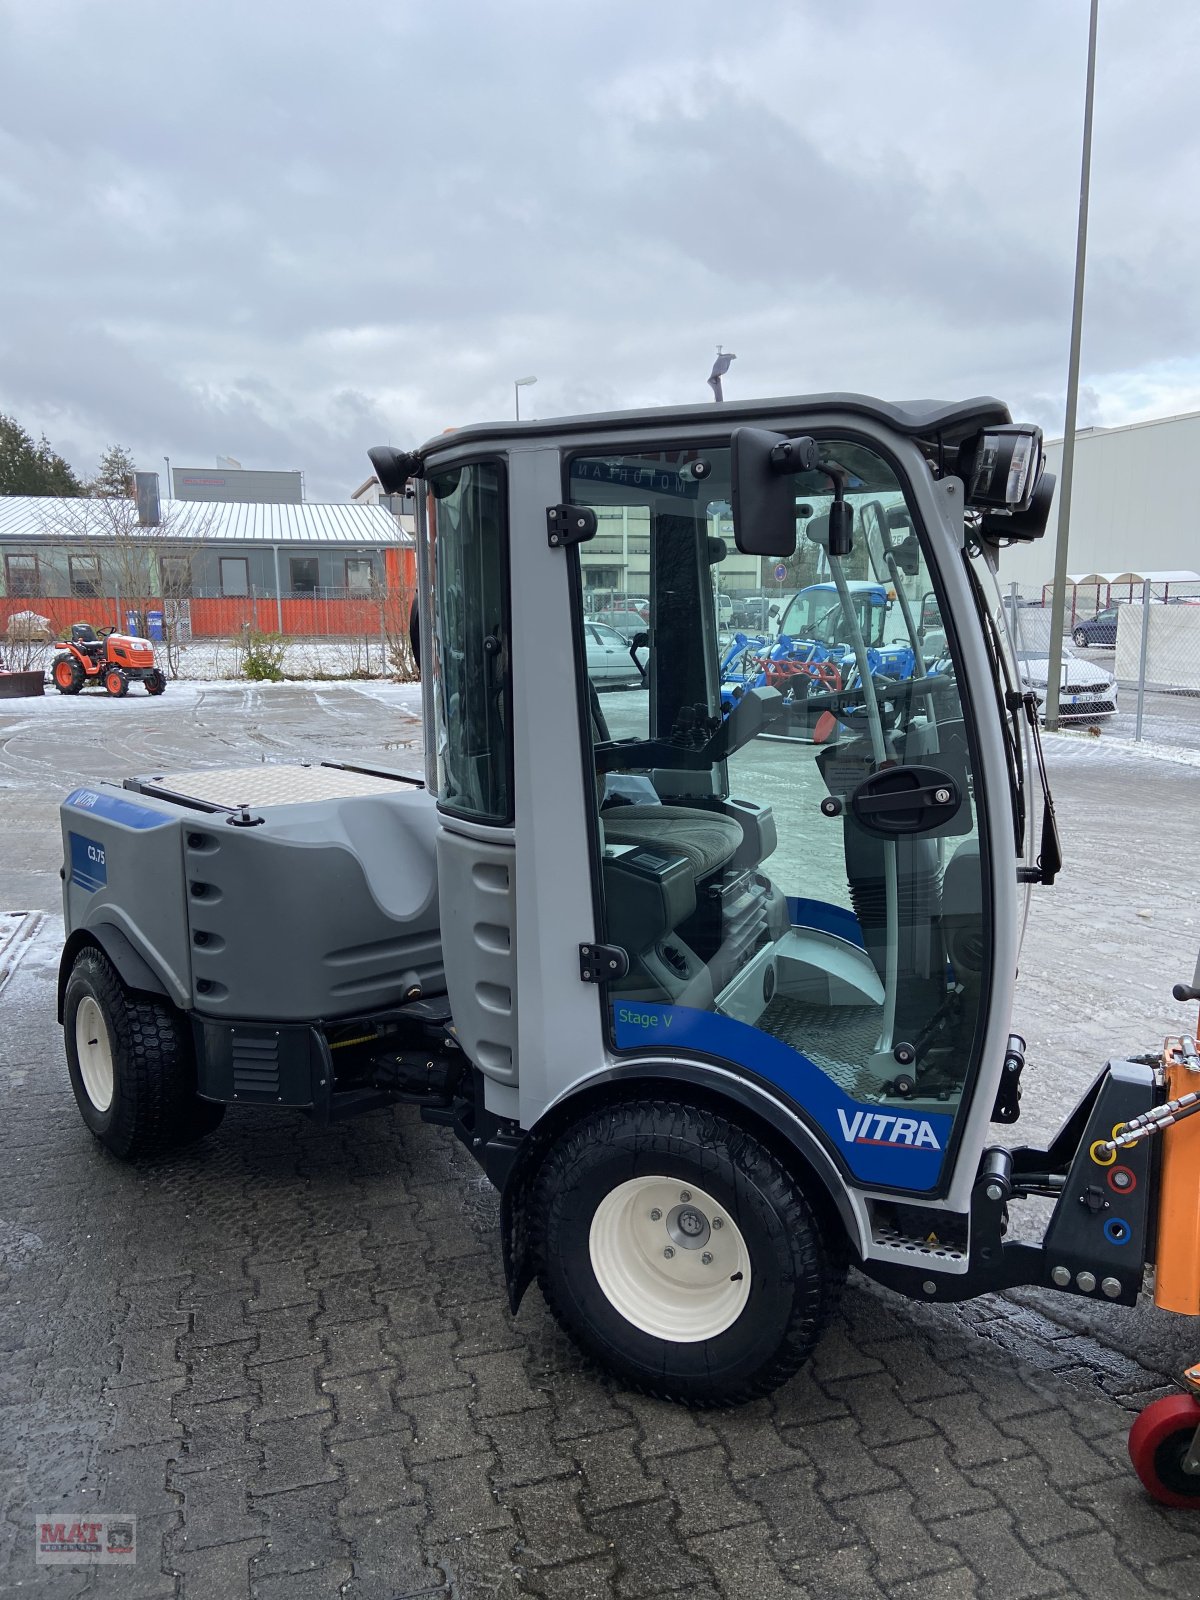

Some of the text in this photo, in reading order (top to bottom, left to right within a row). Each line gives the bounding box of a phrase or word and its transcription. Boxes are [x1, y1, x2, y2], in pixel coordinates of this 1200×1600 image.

[74, 790, 99, 808] VITRA
[87, 845, 105, 865] C3.75
[619, 1009, 673, 1028] Stage V
[837, 1108, 941, 1150] VITRA
